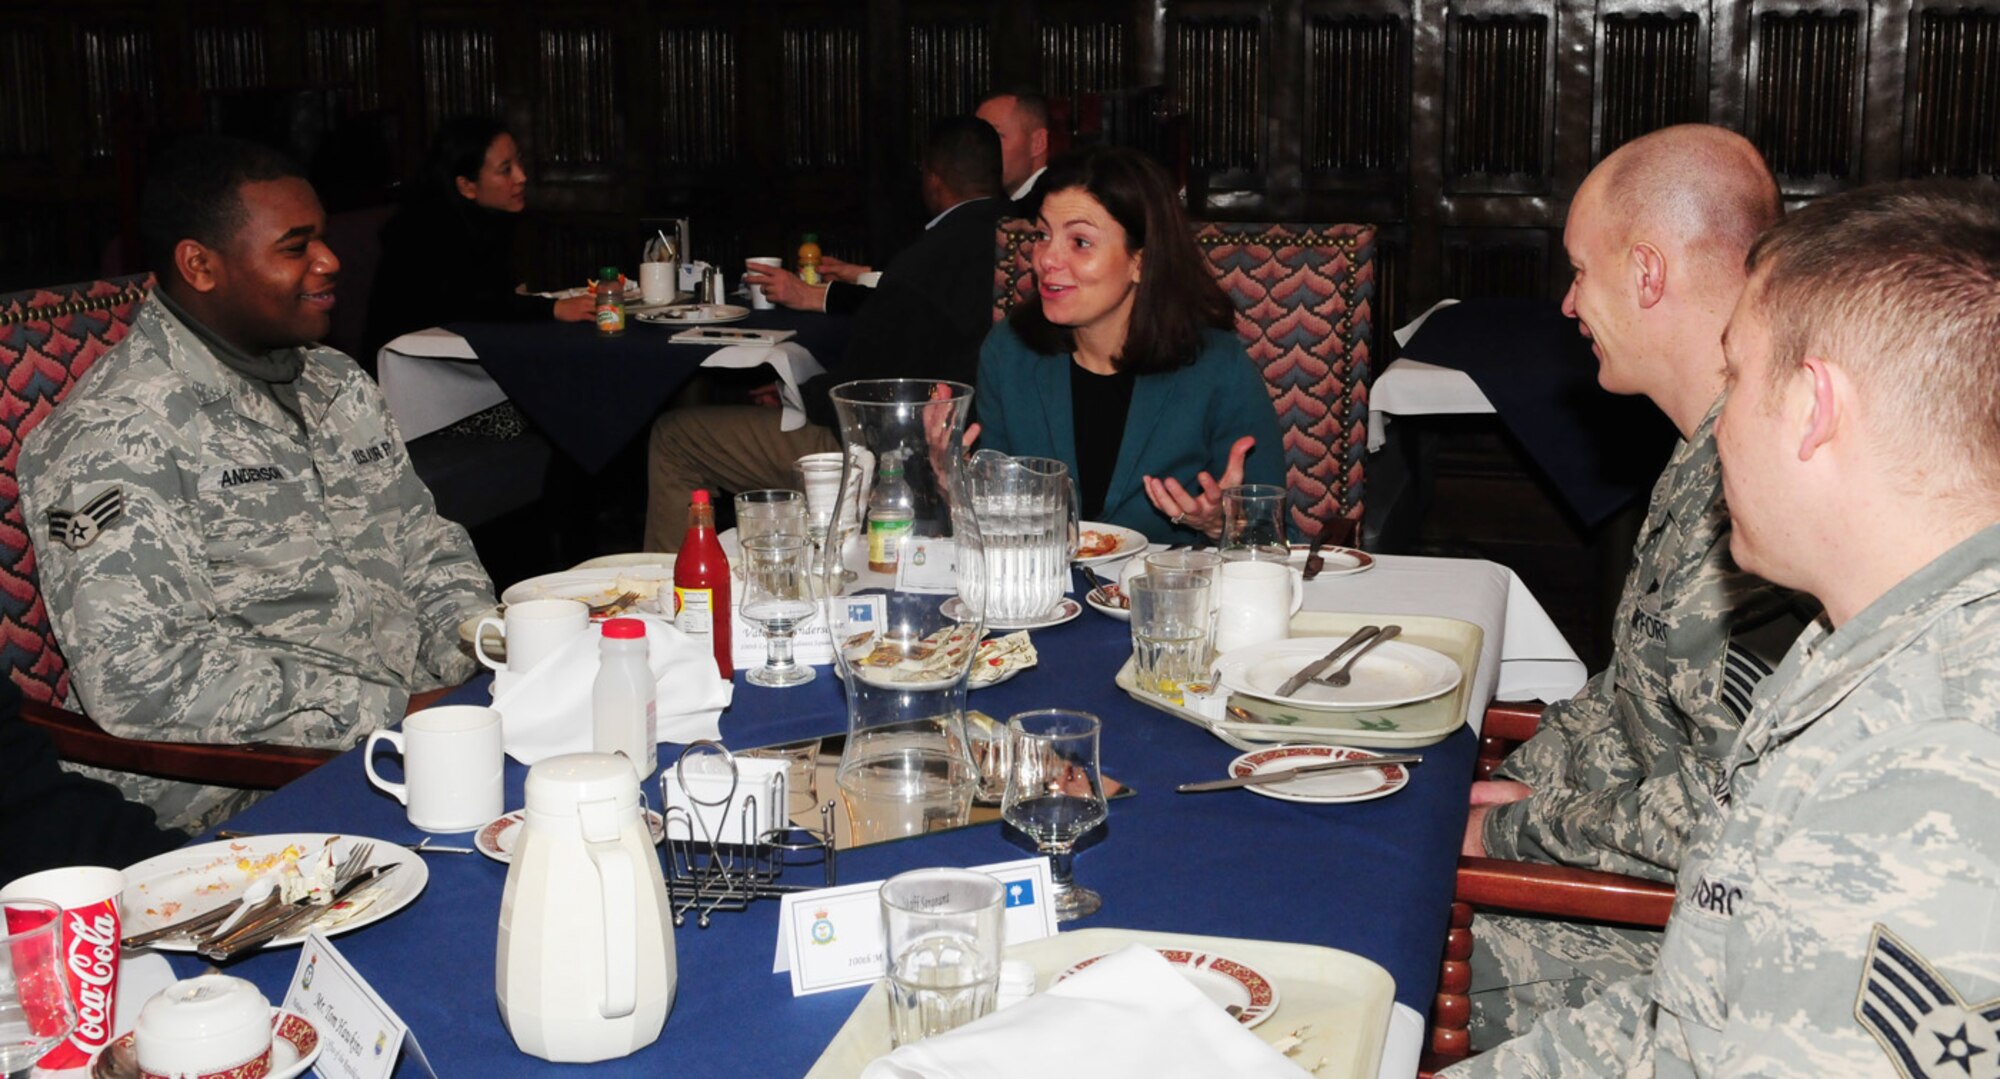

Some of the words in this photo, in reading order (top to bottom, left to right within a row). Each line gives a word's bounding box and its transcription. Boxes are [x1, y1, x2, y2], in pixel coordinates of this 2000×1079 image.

[221, 467, 284, 488] ANDERSON
[69, 911, 115, 1054] Coca-Cola
[324, 1003, 339, 1028] Tom
[335, 1018, 363, 1056] Hawkins
